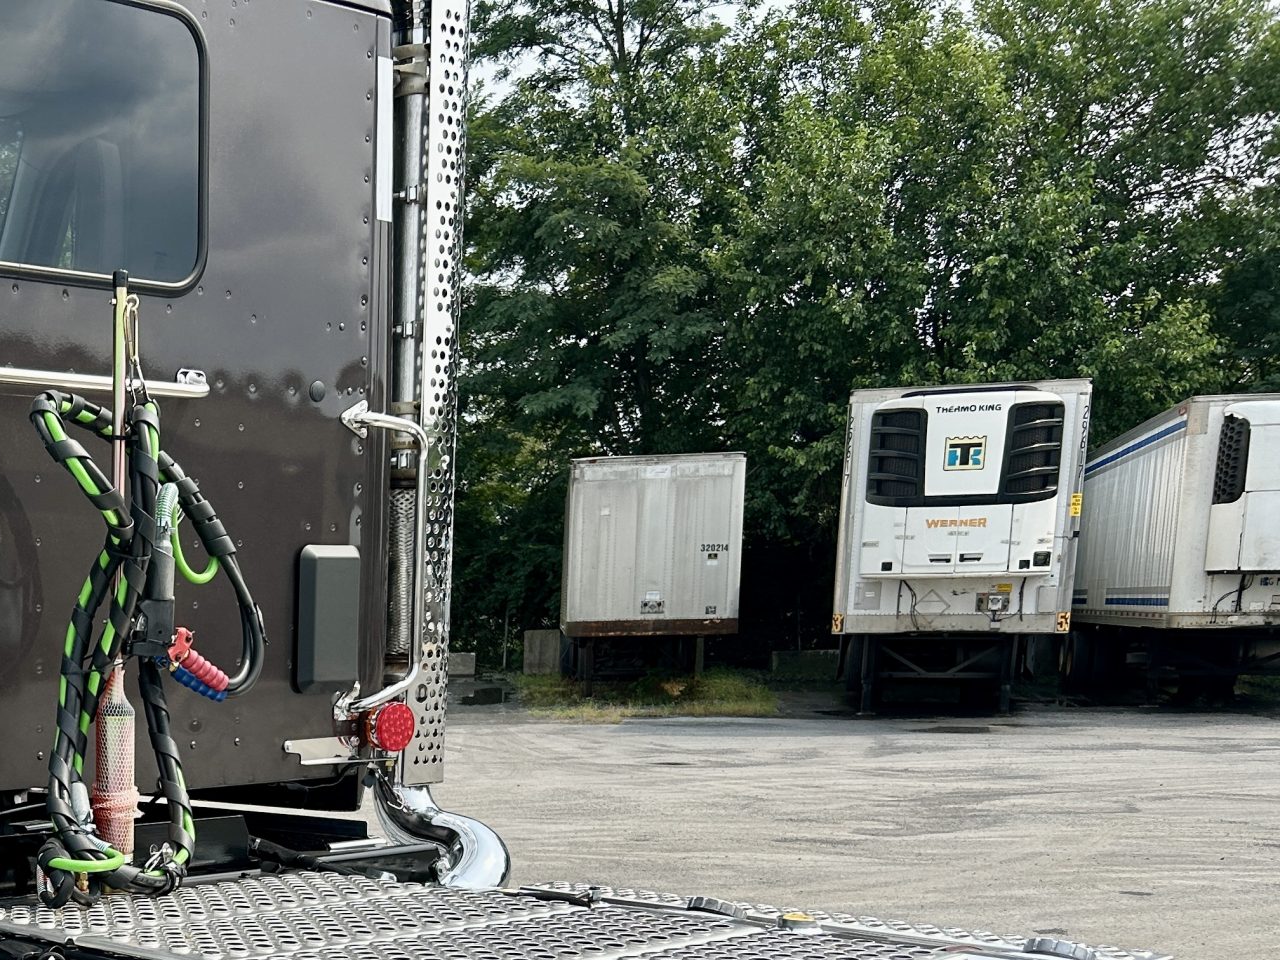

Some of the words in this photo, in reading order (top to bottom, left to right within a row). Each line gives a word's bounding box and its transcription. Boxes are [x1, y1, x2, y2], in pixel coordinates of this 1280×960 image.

[936, 405, 977, 413] THERMO
[978, 404, 1002, 412] KING
[926, 517, 988, 529] WERNER
[700, 543, 729, 552] 320214
